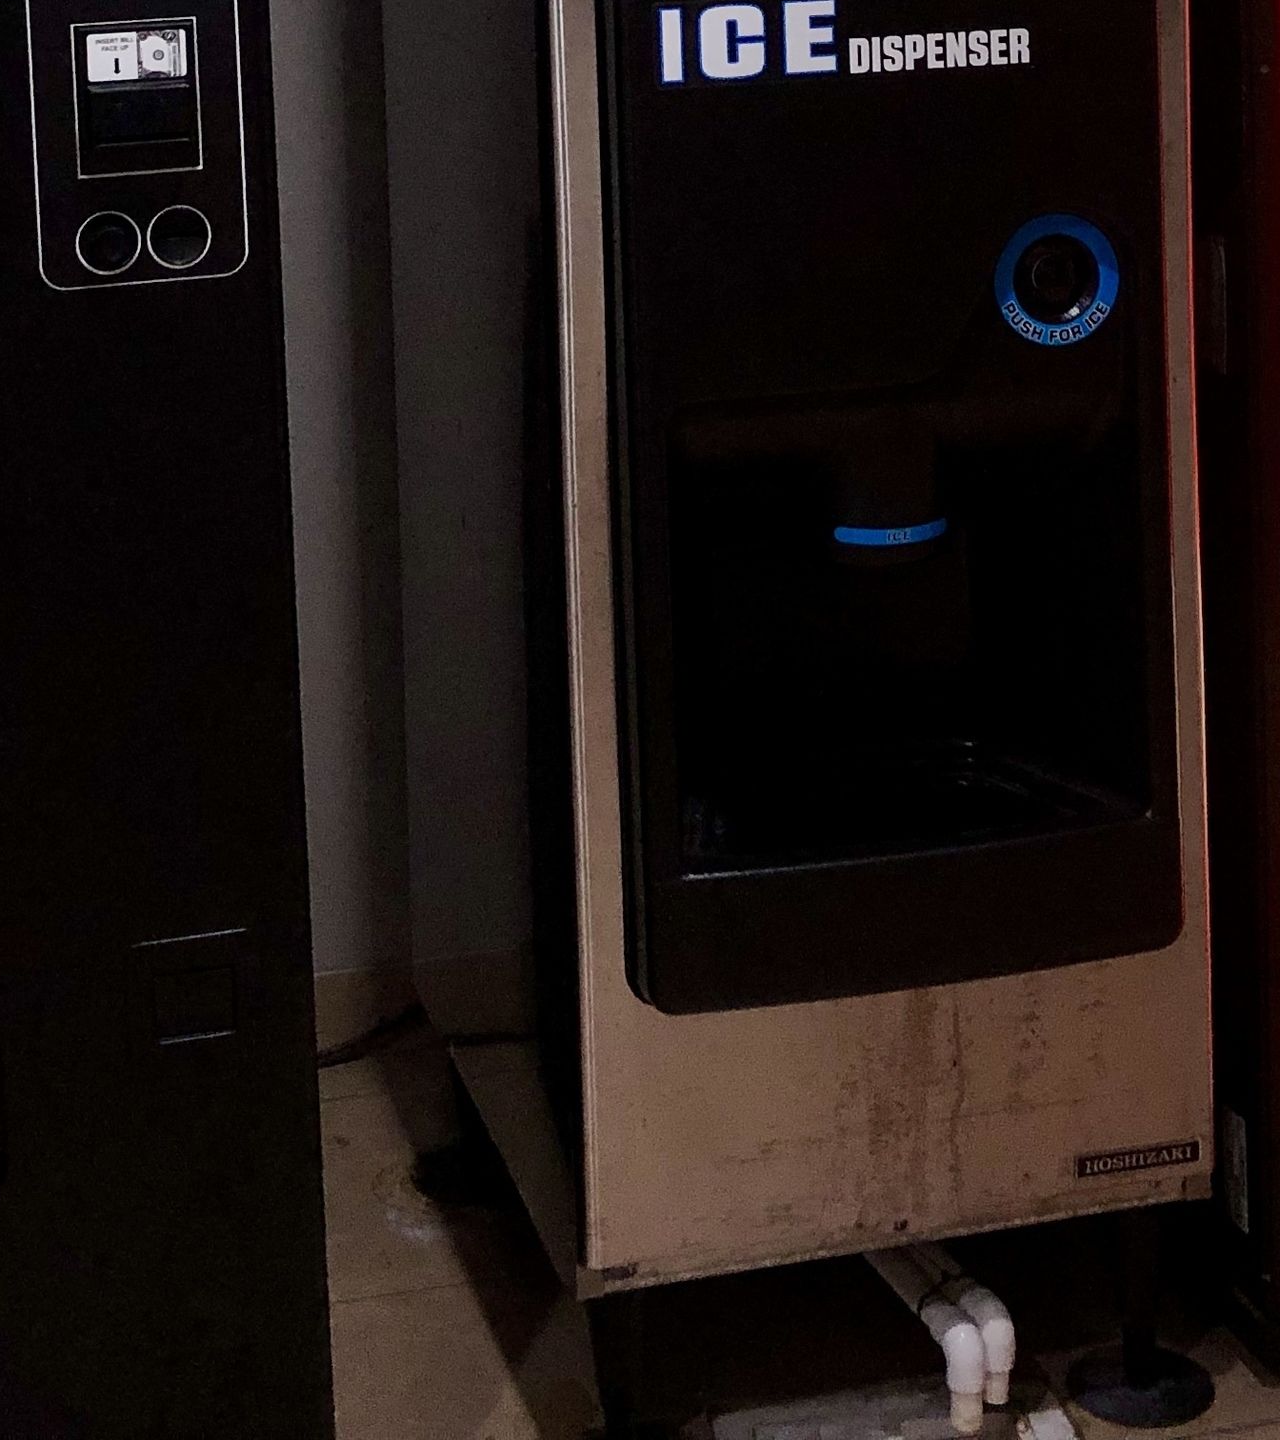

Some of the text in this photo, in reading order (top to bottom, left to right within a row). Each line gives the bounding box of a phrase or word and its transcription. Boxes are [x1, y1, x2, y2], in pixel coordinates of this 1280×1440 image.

[848, 26, 1031, 75] DISPENSER
[1001, 299, 1111, 345] PUSH FOR ICE
[1084, 1145, 1193, 1176] HOSHIZAKI
